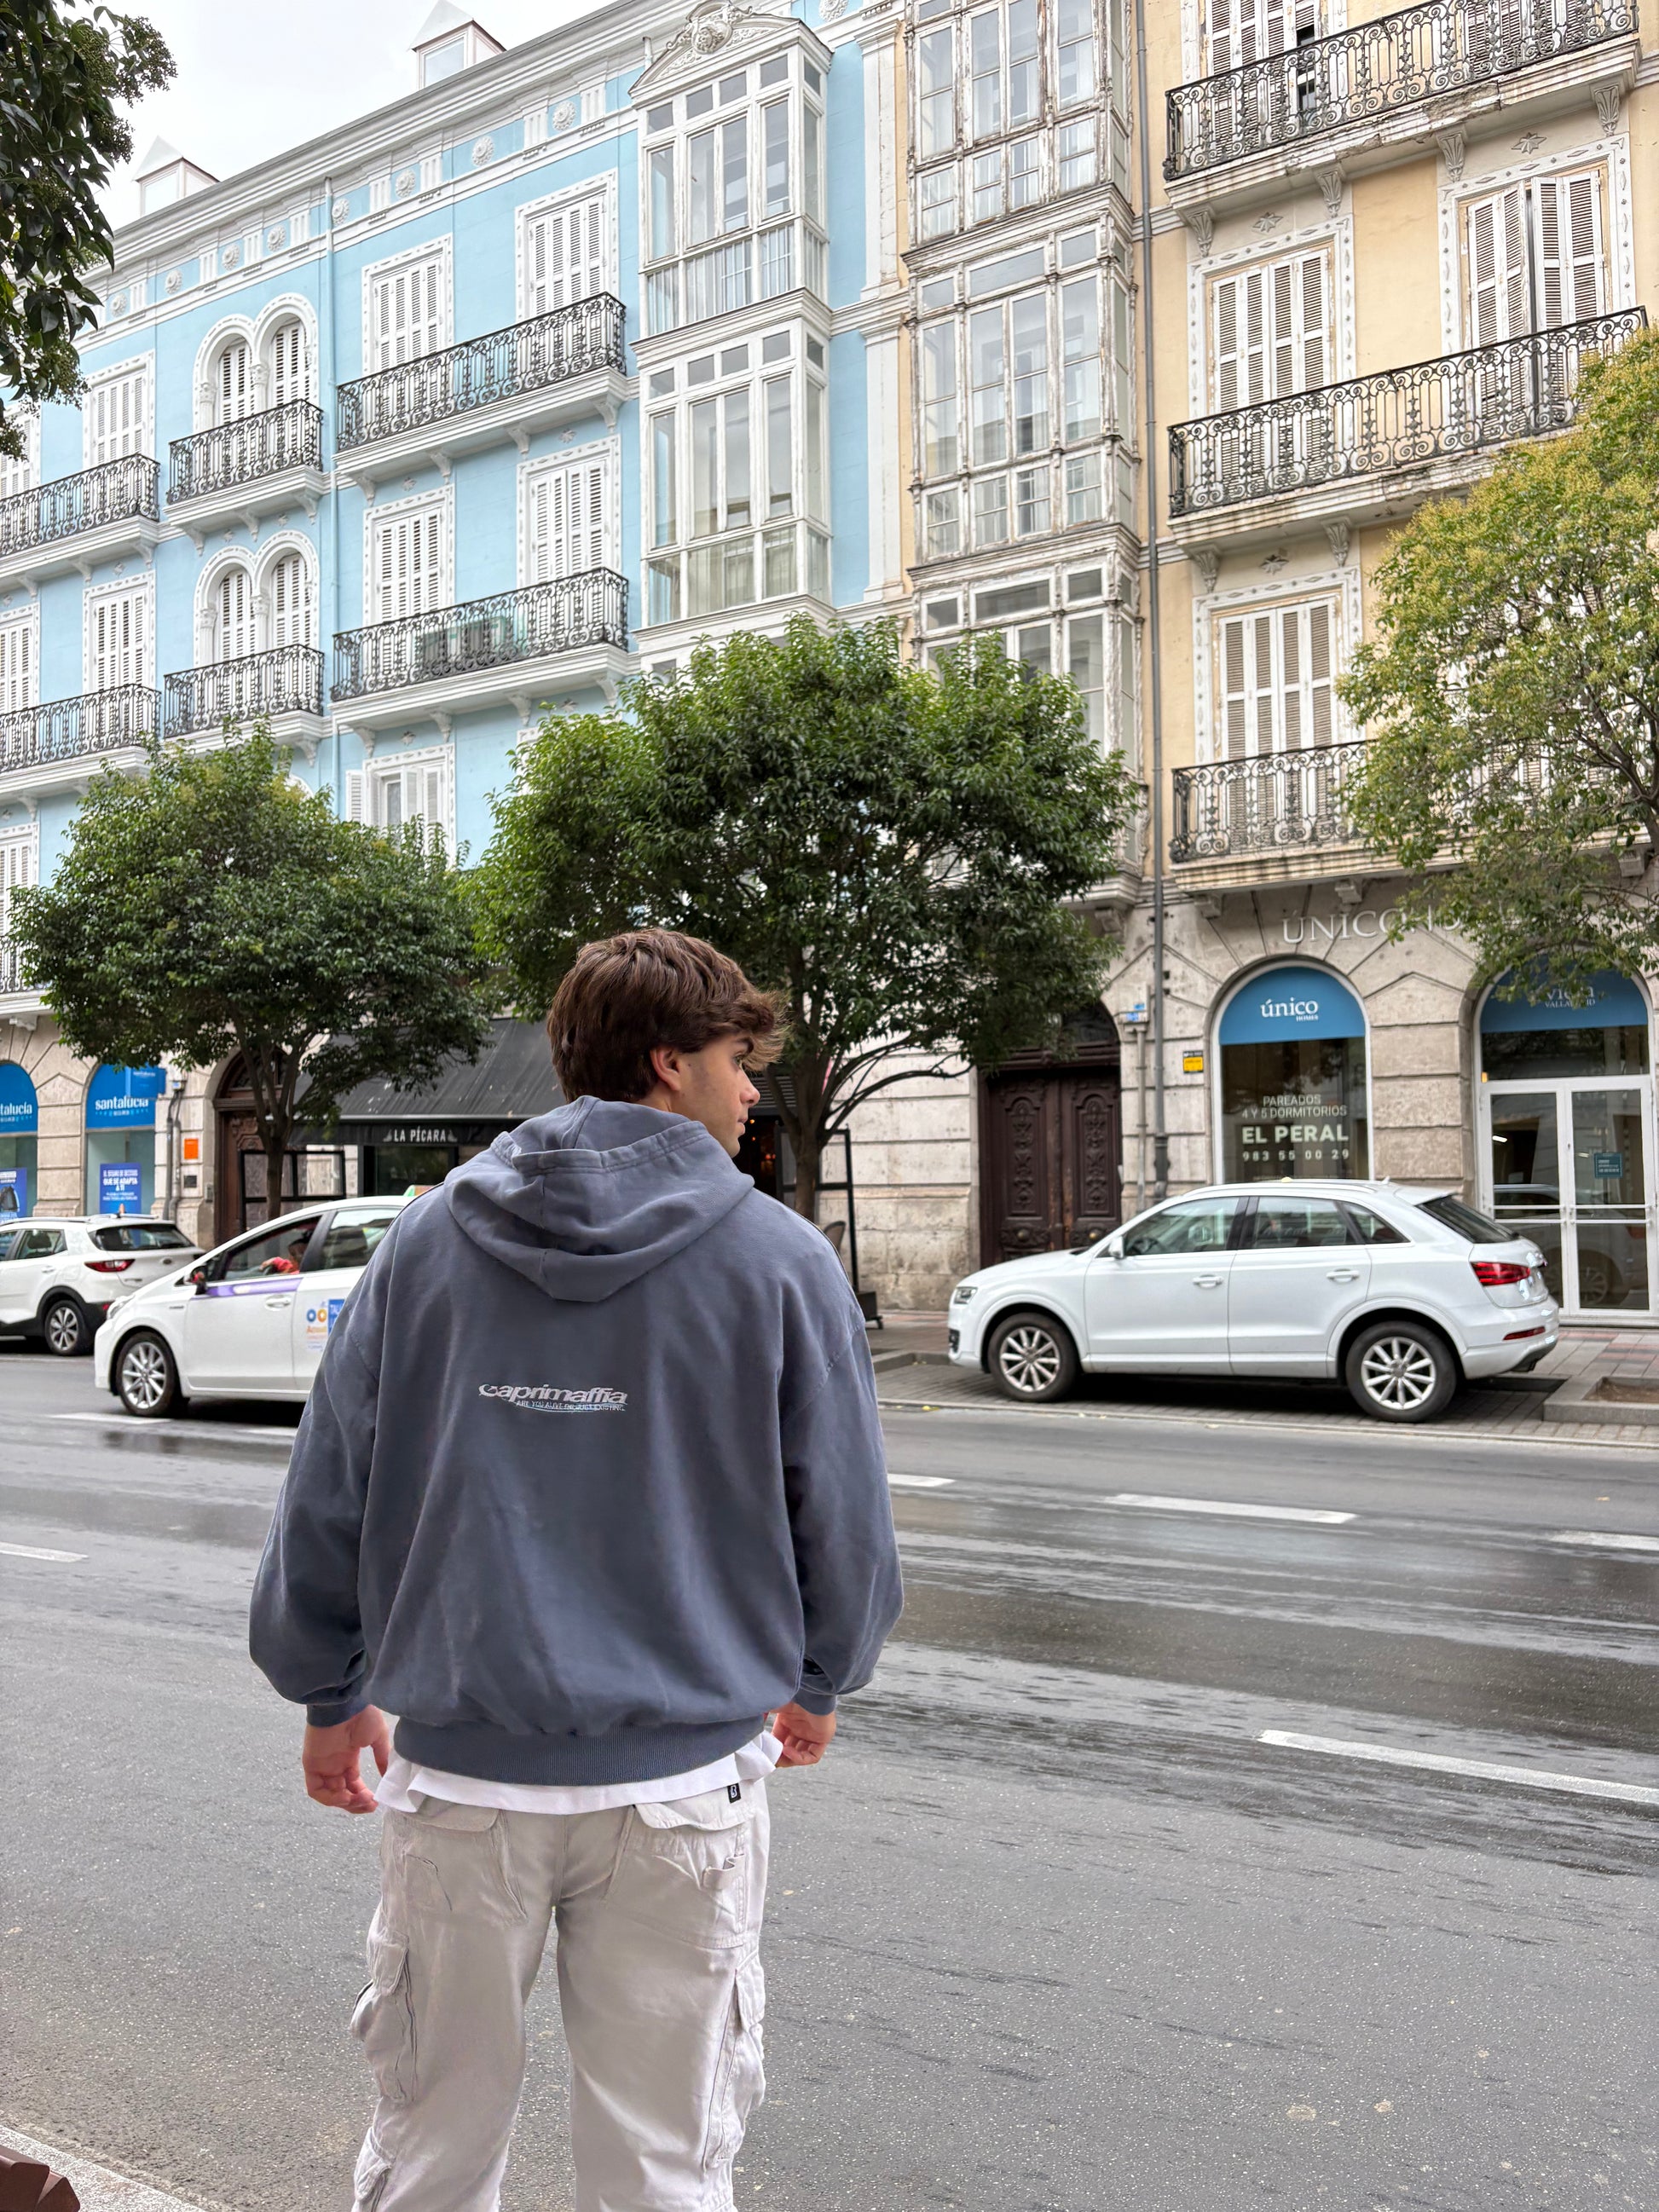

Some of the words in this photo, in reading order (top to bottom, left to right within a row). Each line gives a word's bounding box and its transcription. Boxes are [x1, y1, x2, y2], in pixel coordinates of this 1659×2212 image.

[1260, 996, 1319, 1018] único
[1263, 1094, 1321, 1107] PAREADOS
[1242, 1109, 1248, 1119] 4
[1251, 1109, 1258, 1119] Y
[1270, 1105, 1348, 1119] DORMITORIOS
[394, 1129, 406, 1142] LA
[410, 1125, 447, 1142] PÍCARA
[1242, 1126, 1268, 1144] EL
[1275, 1123, 1349, 1143] PERAL
[1304, 1149, 1322, 1160] 00
